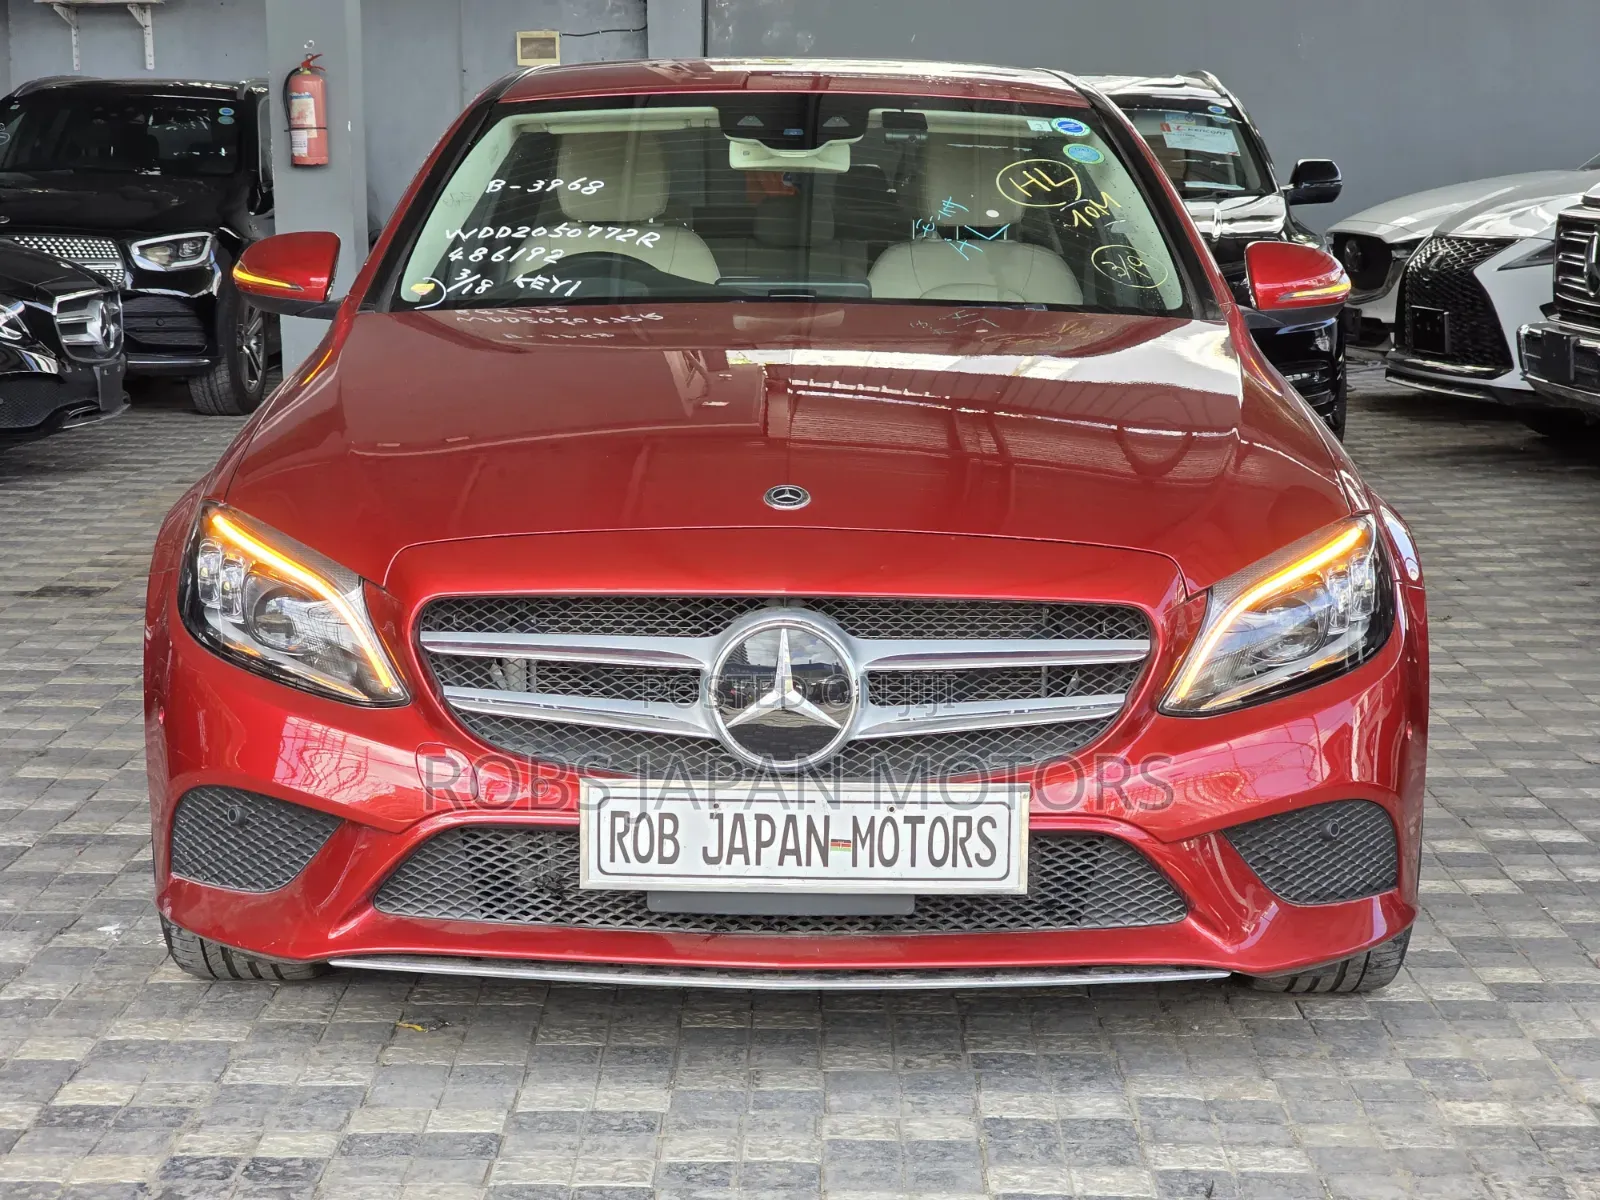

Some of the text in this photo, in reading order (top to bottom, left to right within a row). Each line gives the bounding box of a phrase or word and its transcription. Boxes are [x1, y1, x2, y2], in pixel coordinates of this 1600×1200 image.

[445, 222, 661, 248] WDD2050772R
[448, 246, 565, 264] 486192
[610, 810, 997, 868] ROB JAPAN MOTORS
